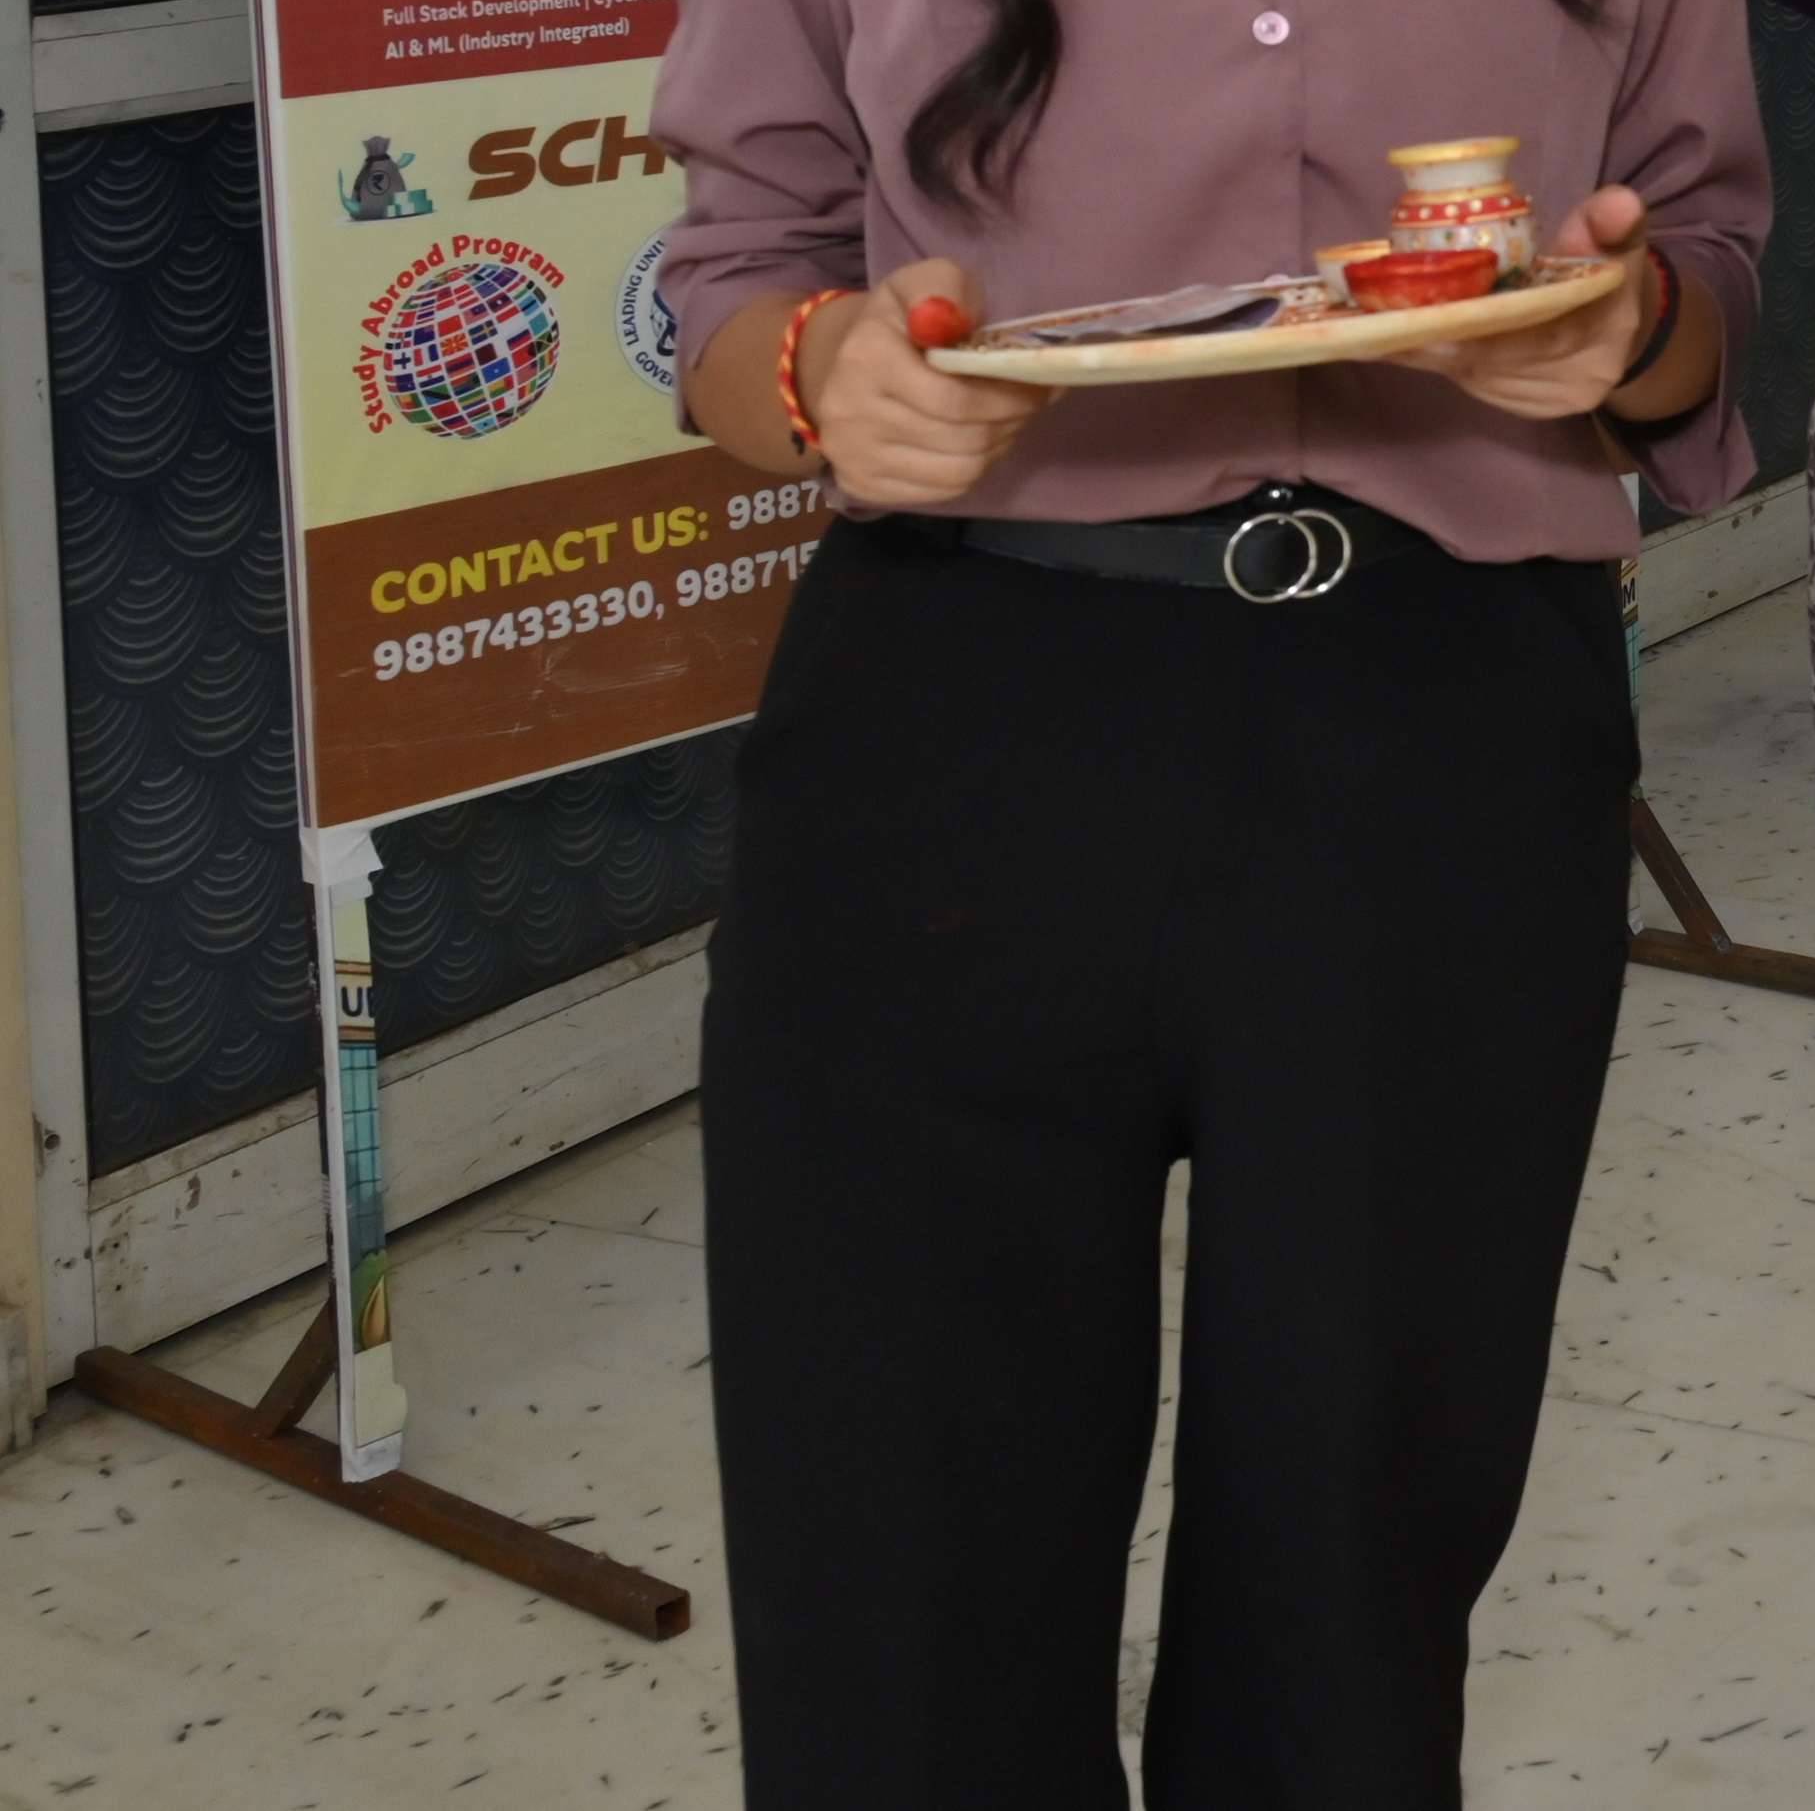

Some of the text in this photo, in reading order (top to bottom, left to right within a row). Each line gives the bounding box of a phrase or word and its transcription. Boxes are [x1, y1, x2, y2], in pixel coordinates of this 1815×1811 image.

[383, 7, 415, 26] Full
[420, 2, 468, 24] Stack
[385, 17, 631, 59] AI & ML (Industry Integrated)
[468, 115, 668, 201] SCH
[352, 234, 566, 434] Study Abroad Program
[622, 274, 643, 346] LEADING
[371, 479, 836, 614] CONTACT US: 9887
[373, 580, 665, 681] 9887433330,
